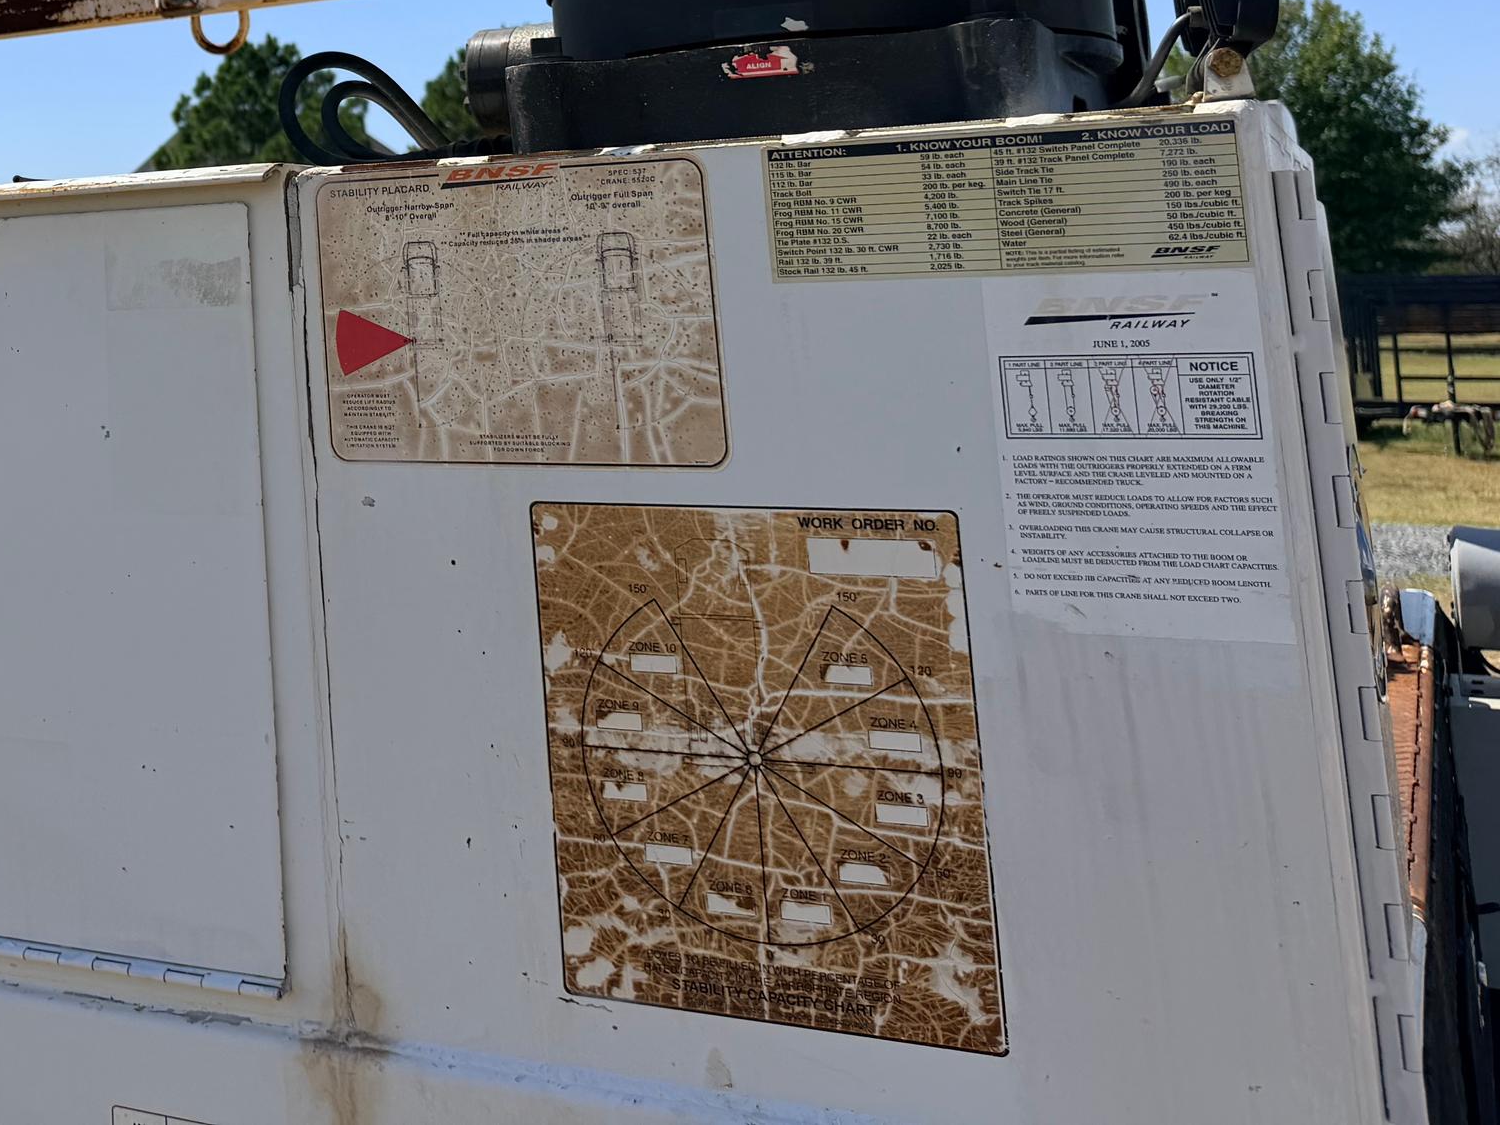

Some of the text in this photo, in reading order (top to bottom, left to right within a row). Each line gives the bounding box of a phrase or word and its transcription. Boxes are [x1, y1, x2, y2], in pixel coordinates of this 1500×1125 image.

[771, 149, 846, 159] ATTENTION:
[910, 140, 950, 151] KNOW
[954, 138, 991, 148] YOUR
[996, 136, 1042, 145] BOOM!
[1097, 129, 1141, 140] KNOW
[1145, 126, 1185, 136] YOUR
[1190, 123, 1230, 133] LOAD
[446, 163, 559, 182] BNSF
[995, 168, 1014, 176] Side
[496, 182, 549, 191] RAILWAY
[968, 181, 985, 189] keg.
[330, 185, 429, 198] STABILITY PLACARD
[571, 193, 610, 201] Outrigger
[632, 190, 653, 198] Span
[998, 197, 1053, 207] Track Spikes
[1041, 207, 1081, 216] (General)
[1027, 217, 1067, 227] (General)
[1025, 228, 1065, 237] (General)
[1155, 245, 1221, 254] BNSF
[1110, 319, 1190, 329] RAILWAY
[1093, 340, 1150, 349] JUNE 1, 2005
[1189, 361, 1239, 371] NOTICE
[1127, 455, 1154, 463] CHART
[797, 517, 939, 531] WORK ORDER NO.
[1115, 592, 1141, 600] CRANE
[629, 641, 676, 653] ZONE 10
[822, 652, 857, 663] ZONE
[597, 699, 639, 710] ZONE 9
[870, 717, 917, 730] ZONE 4
[604, 768, 634, 779] ZONE
[877, 790, 924, 804] ZONE 3
[648, 831, 689, 844] ZONE 7
[840, 849, 887, 863] ZONE 2
[709, 880, 744, 893] ZONE
[783, 888, 826, 901] ZONE 1
[672, 978, 741, 1000] STABILITY
[748, 989, 818, 1010] CAPACITY
[824, 1000, 876, 1017] CHART
